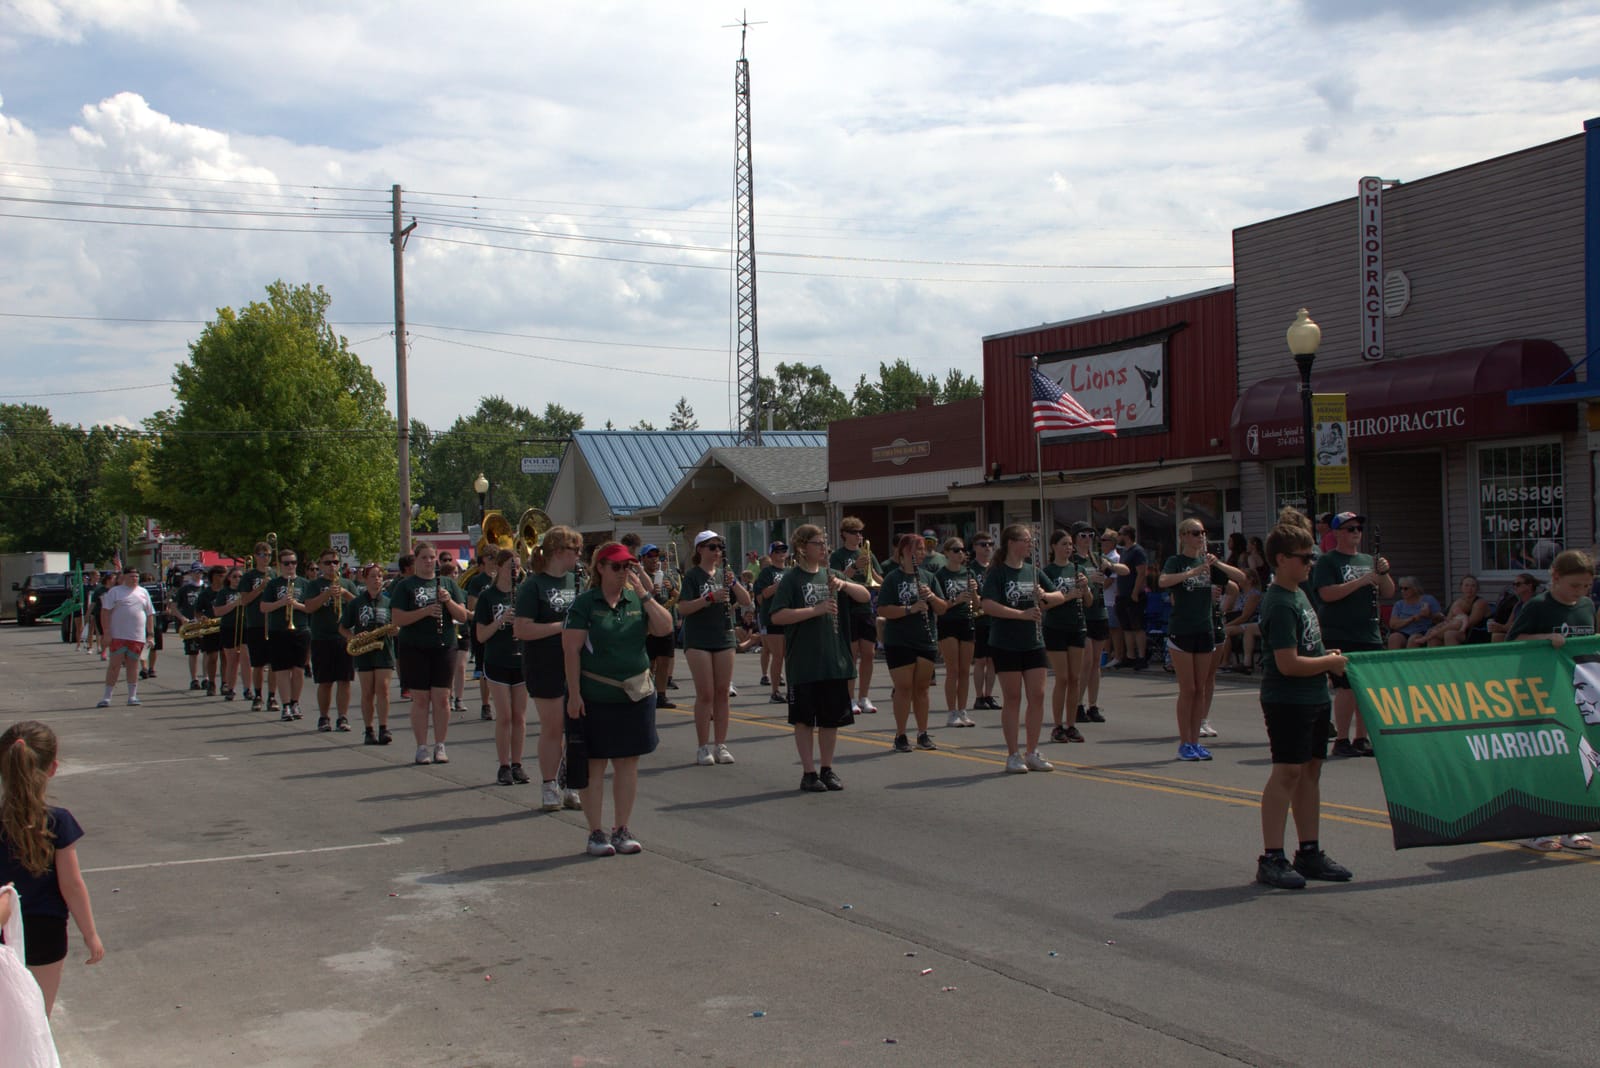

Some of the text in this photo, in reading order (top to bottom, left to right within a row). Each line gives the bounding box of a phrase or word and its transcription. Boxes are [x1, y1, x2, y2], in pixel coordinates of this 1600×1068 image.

[1365, 179, 1380, 358] CHIROPRACTIC
[1070, 364, 1128, 392] Lions
[1090, 399, 1137, 423] rate
[1347, 407, 1465, 438] HIROPRACTIC
[1481, 484, 1563, 505] Massage
[1485, 514, 1562, 536] Therapy
[1367, 677, 1557, 726] WAWASEE
[1465, 729, 1570, 761] WARRIOR
